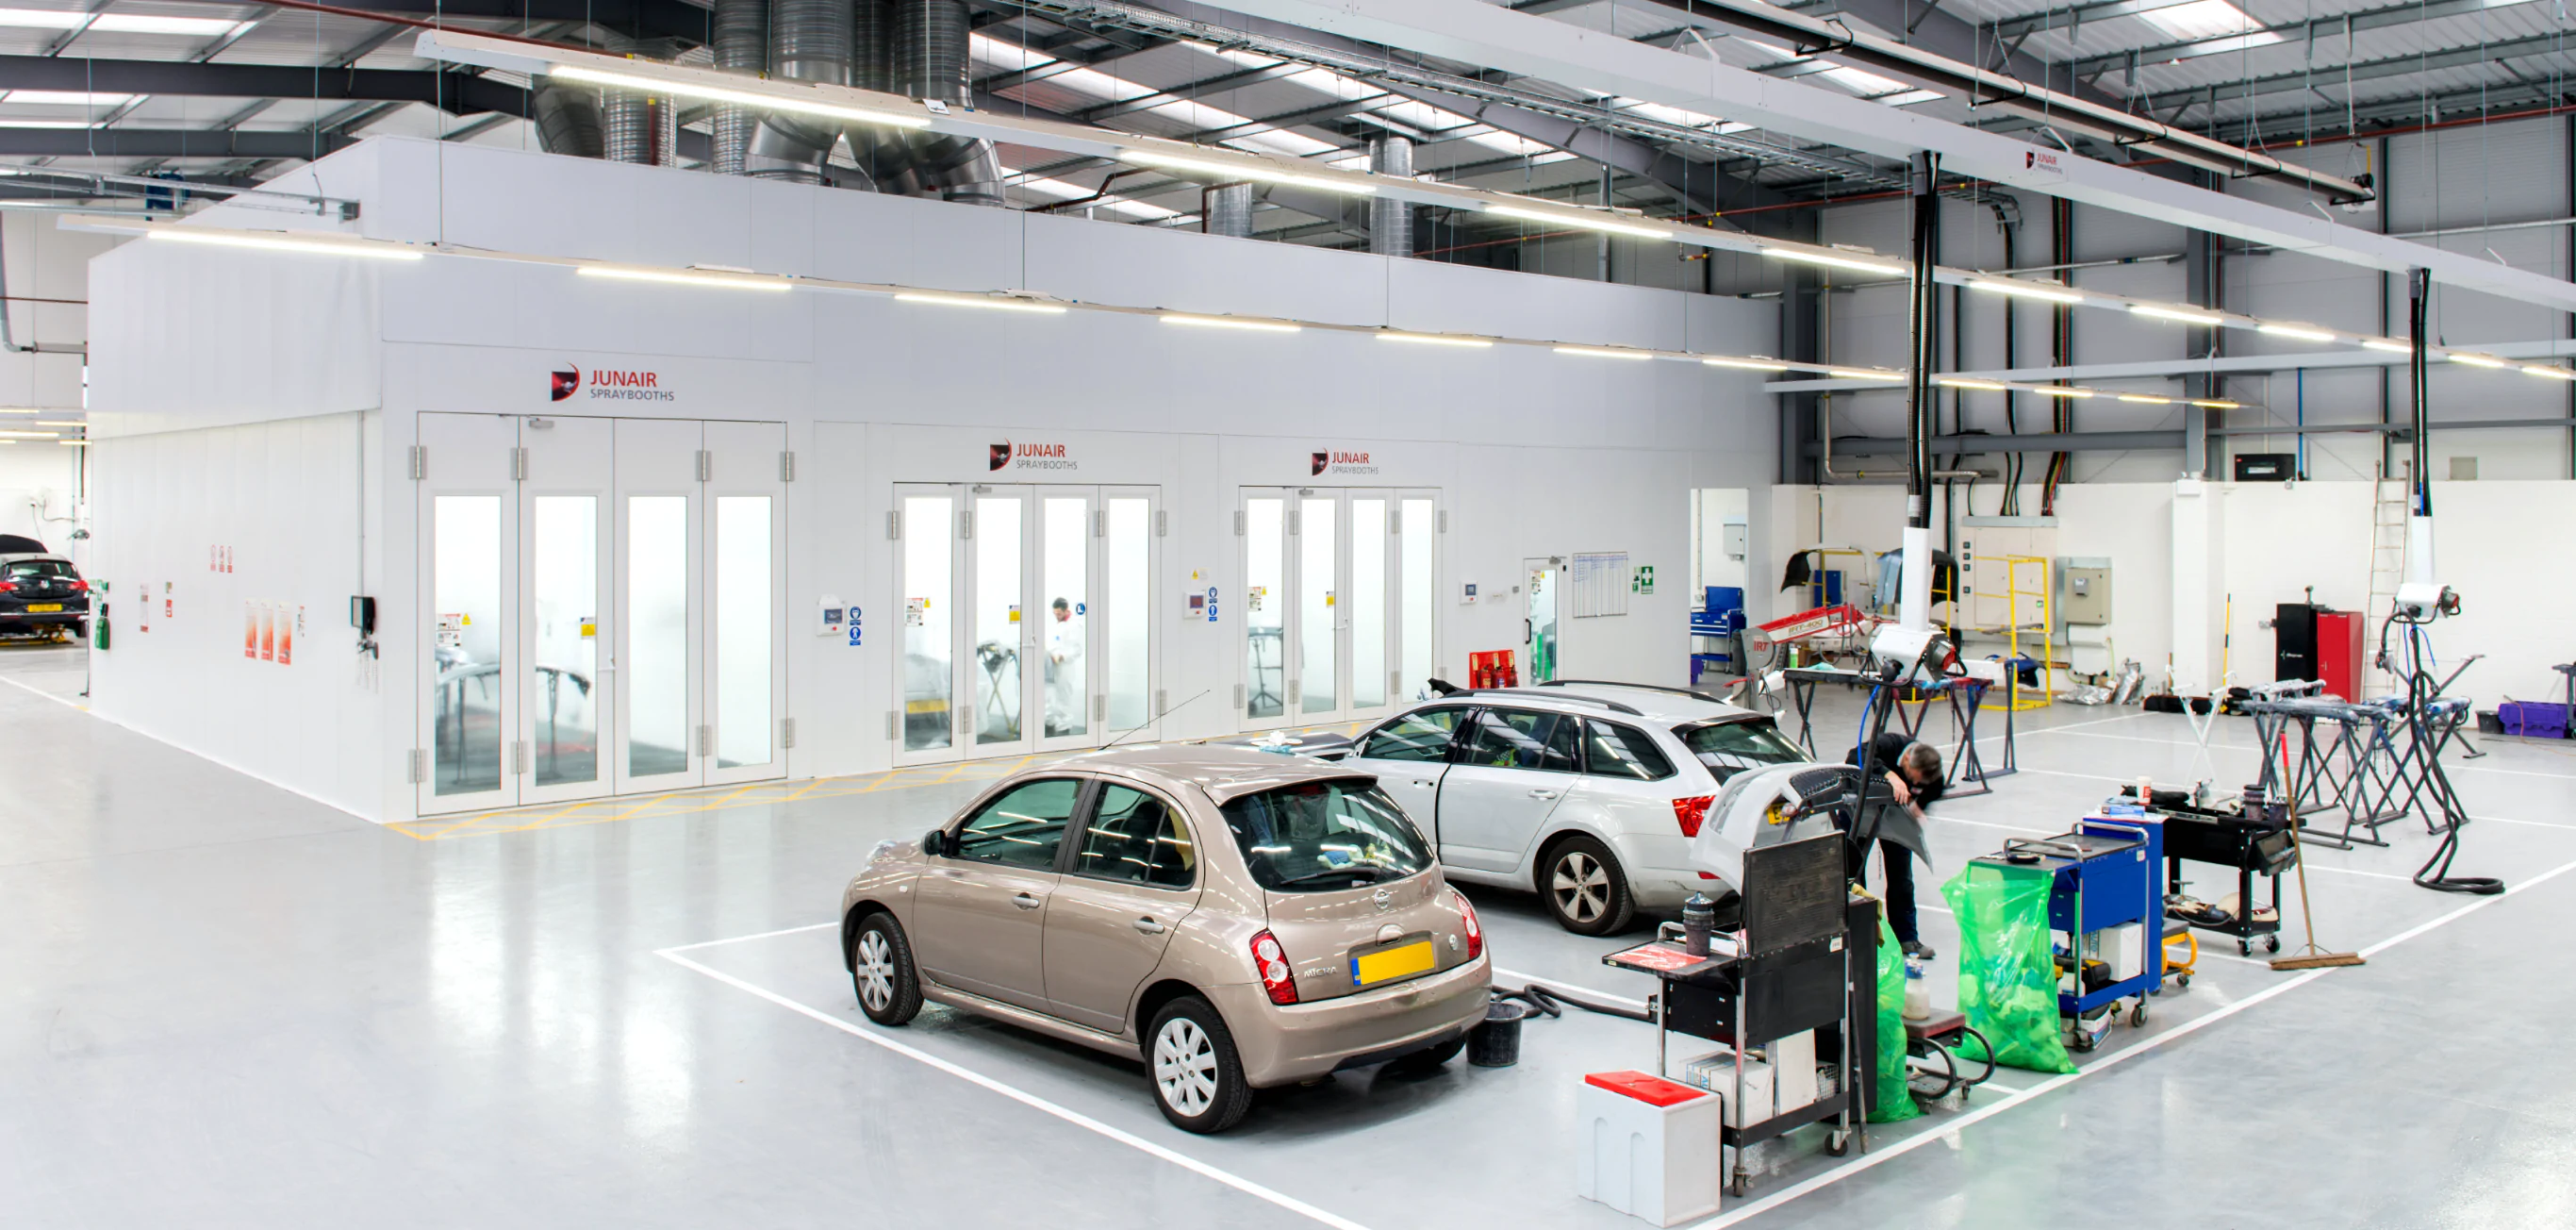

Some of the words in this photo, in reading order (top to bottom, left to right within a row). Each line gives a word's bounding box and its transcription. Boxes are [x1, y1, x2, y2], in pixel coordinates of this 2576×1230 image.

[589, 370, 657, 388] JUNAIR
[590, 389, 675, 401] SPRAYBOOTHS
[1016, 443, 1065, 457] JUNAIR
[1331, 452, 1369, 464] JUNAIR
[1016, 459, 1078, 470] SPRAYBOOTHS
[1331, 466, 1379, 474] SPRAYBOOTHS
[1754, 640, 1769, 652] IRT
[1304, 966, 1337, 978] MICRA
